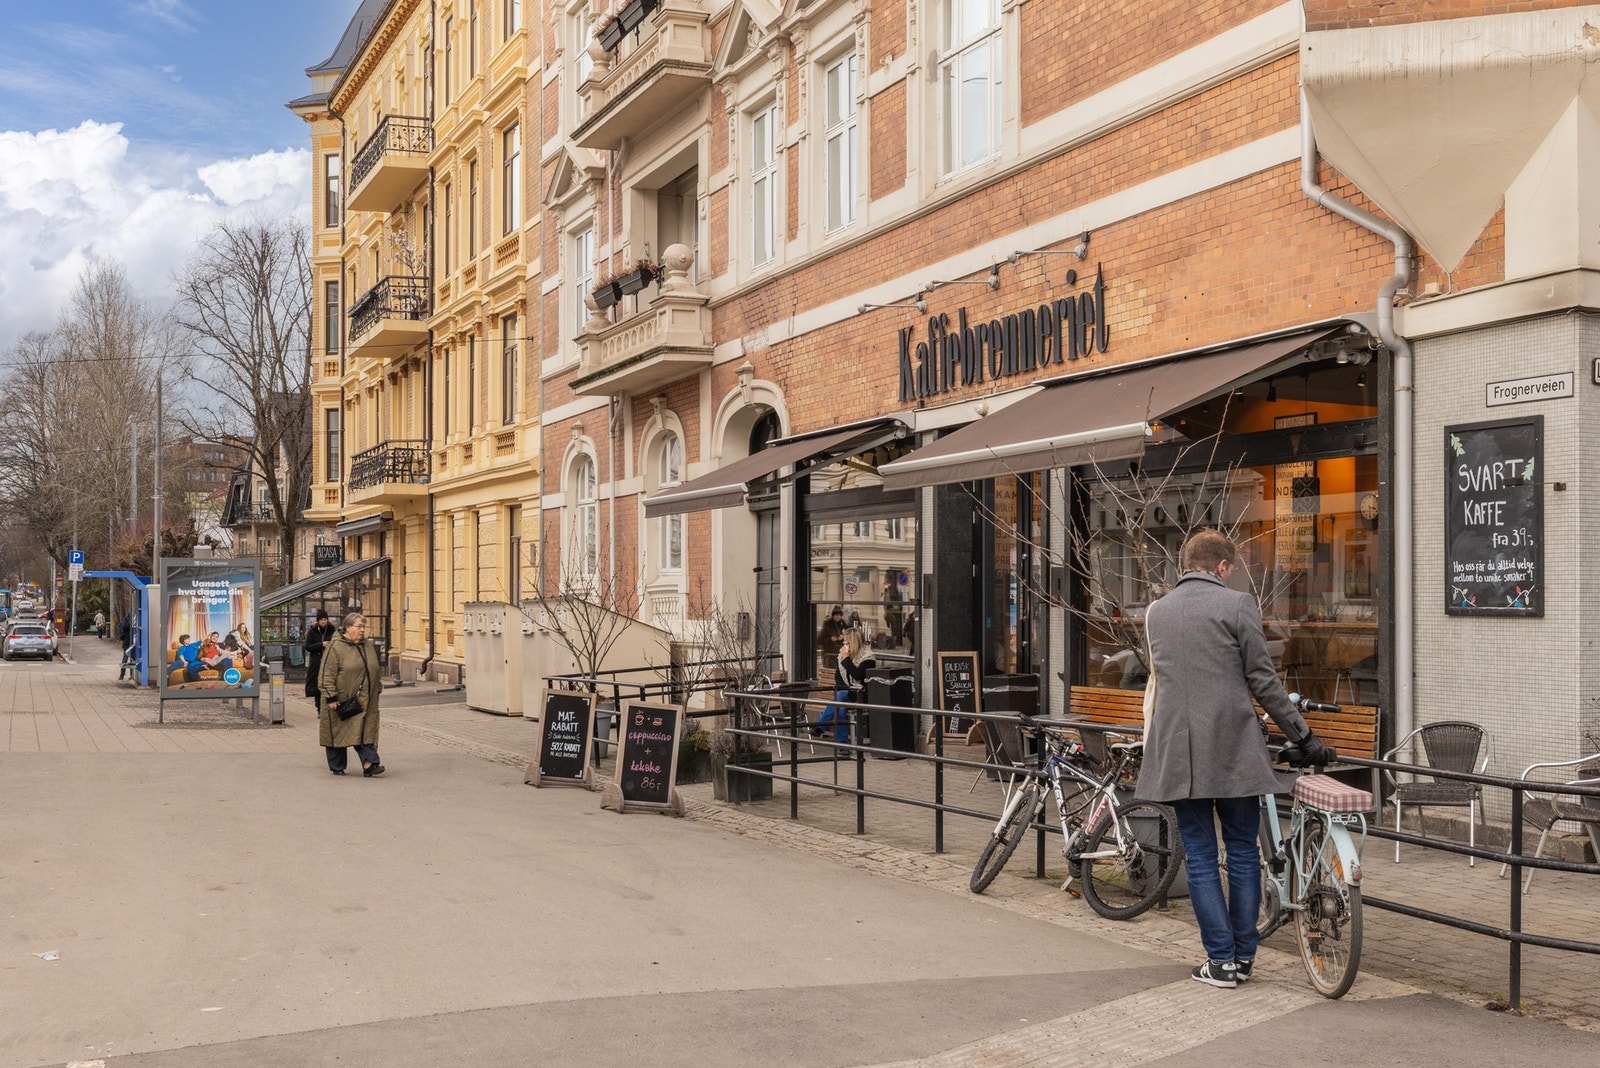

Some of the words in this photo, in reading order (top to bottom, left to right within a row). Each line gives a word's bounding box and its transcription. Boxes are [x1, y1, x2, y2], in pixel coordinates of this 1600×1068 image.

[897, 261, 1110, 402] Kaffebrenneriet
[1494, 379, 1565, 399] Frognerveien
[1458, 458, 1524, 492] SVART
[1463, 499, 1507, 526] KAFFE
[1492, 533, 1508, 548] fra
[73, 552, 80, 562] P
[1453, 561, 1464, 573] Hos
[1465, 563, 1475, 571] oss
[1488, 559, 1495, 570] du
[1498, 558, 1516, 570] alltid
[1516, 558, 1534, 573] velge
[1453, 573, 1474, 582] mellom
[1475, 574, 1483, 582] to
[1484, 573, 1502, 582] unike
[1504, 572, 1526, 582] smaker
[178, 588, 196, 596] hva
[197, 588, 227, 597] dagen
[192, 596, 230, 605] bringer.
[558, 711, 576, 721] MAT-
[551, 721, 579, 732] RABATT
[628, 732, 672, 744] cappuccino
[550, 742, 564, 751] 50%
[564, 743, 581, 753] RABATT
